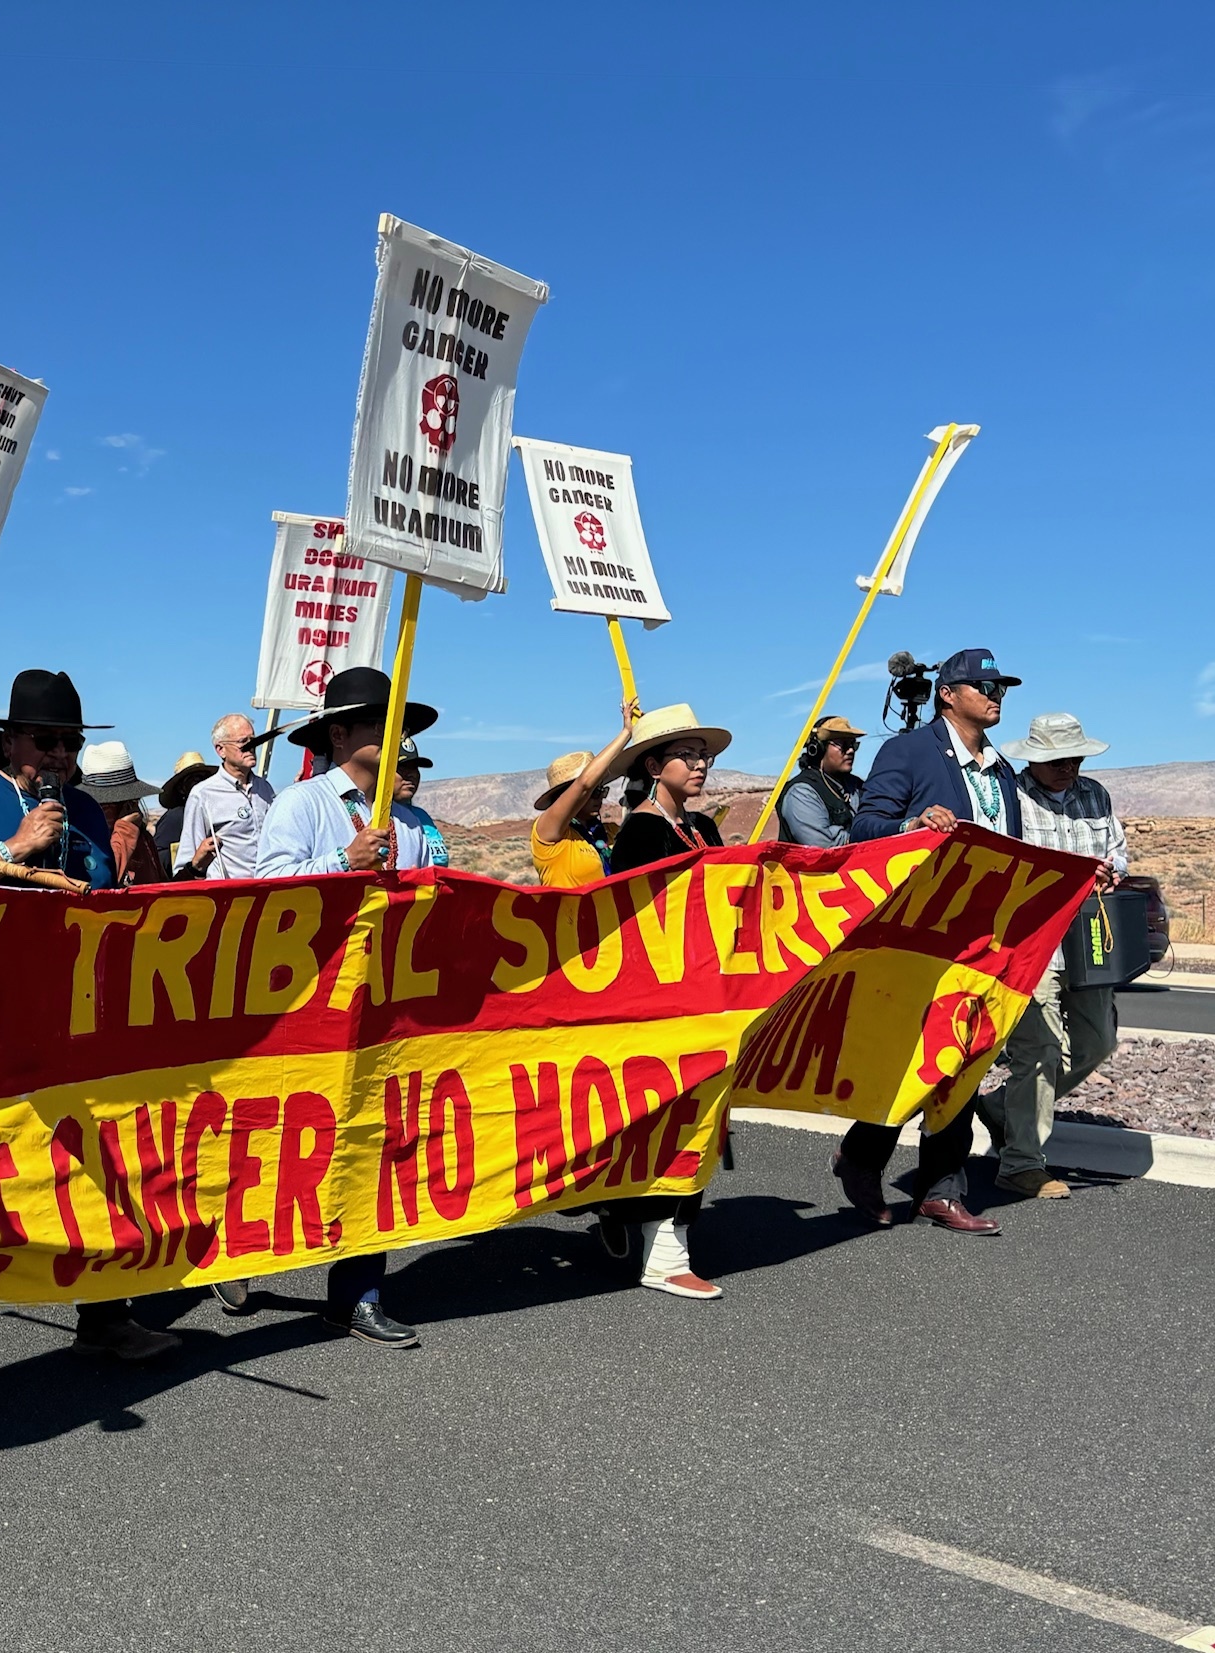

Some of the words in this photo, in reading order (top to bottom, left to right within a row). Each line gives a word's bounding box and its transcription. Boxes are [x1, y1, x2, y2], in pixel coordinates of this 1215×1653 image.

[409, 267, 444, 316] NO
[446, 287, 510, 341] MORE
[401, 319, 490, 381] CANCER
[383, 448, 413, 494] NO
[418, 464, 481, 511] MORE
[543, 458, 566, 482] NO
[568, 465, 616, 491] MORE
[373, 496, 483, 553] URANIUM
[548, 487, 614, 513] CANCER
[313, 522, 345, 540] SH
[563, 555, 588, 577] NO
[590, 560, 637, 582] MORE
[566, 579, 648, 604] URANIUM
[297, 627, 351, 648] NOW!
[64, 884, 440, 1036] TRIBAL
[1089, 917, 1104, 966] SHURE
[376, 1068, 475, 1233] NO
[509, 1050, 728, 1209] MORE
